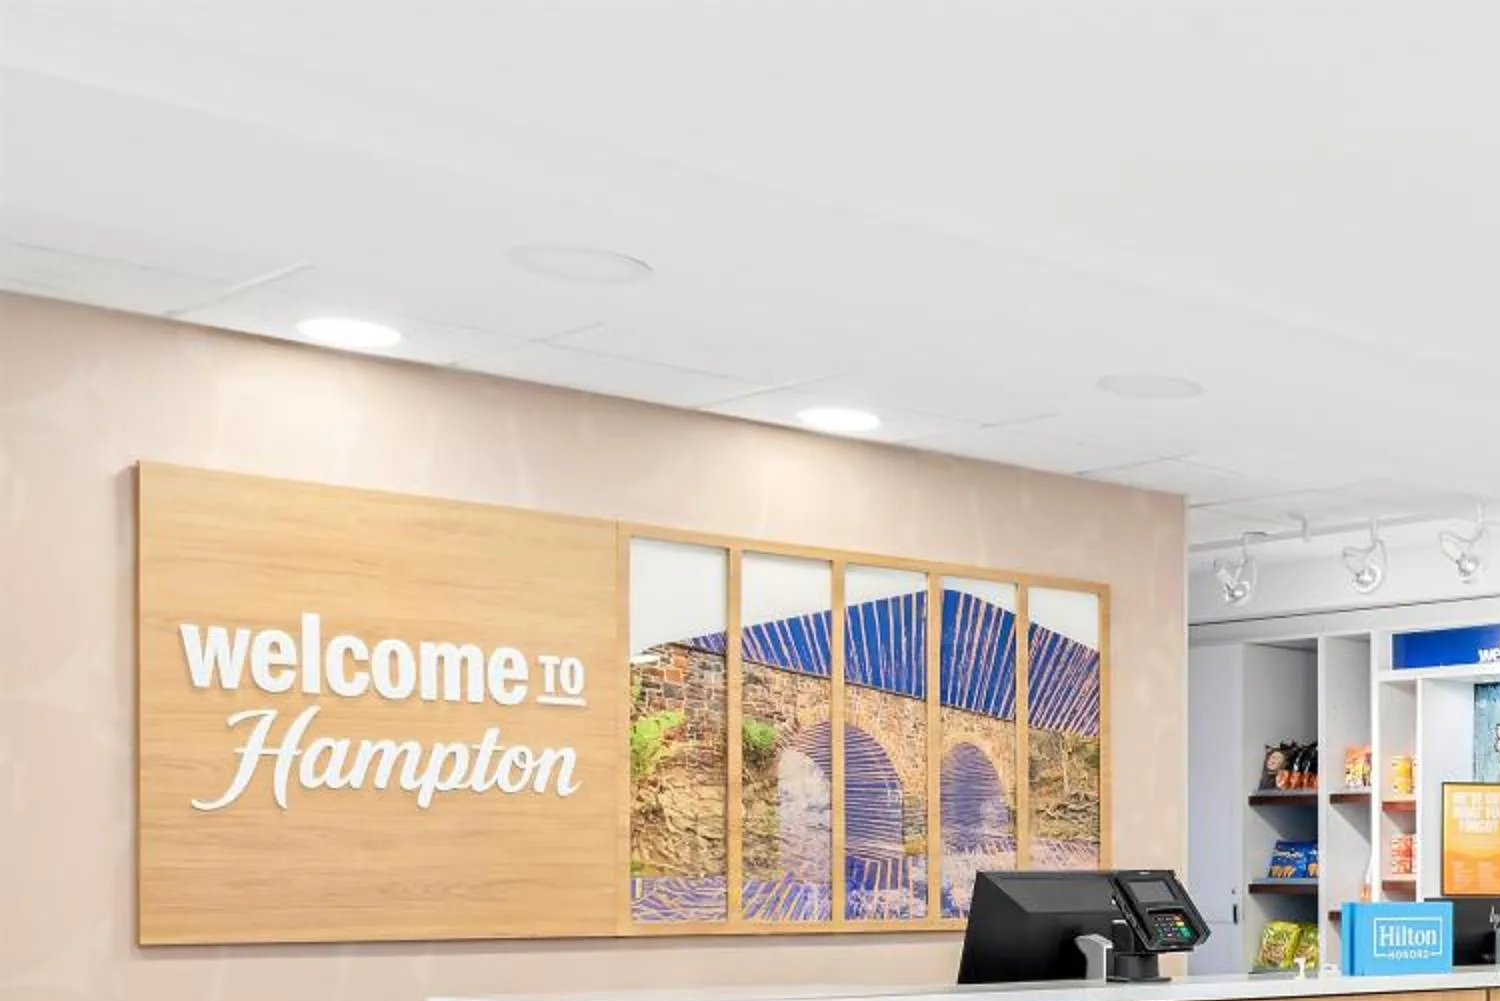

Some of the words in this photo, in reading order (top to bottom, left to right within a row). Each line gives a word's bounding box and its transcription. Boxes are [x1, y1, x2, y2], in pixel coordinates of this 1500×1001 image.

[179, 611, 529, 706] welcome
[536, 654, 586, 697] TO
[191, 705, 582, 810] Hampton
[1379, 925, 1437, 946] Hilton
